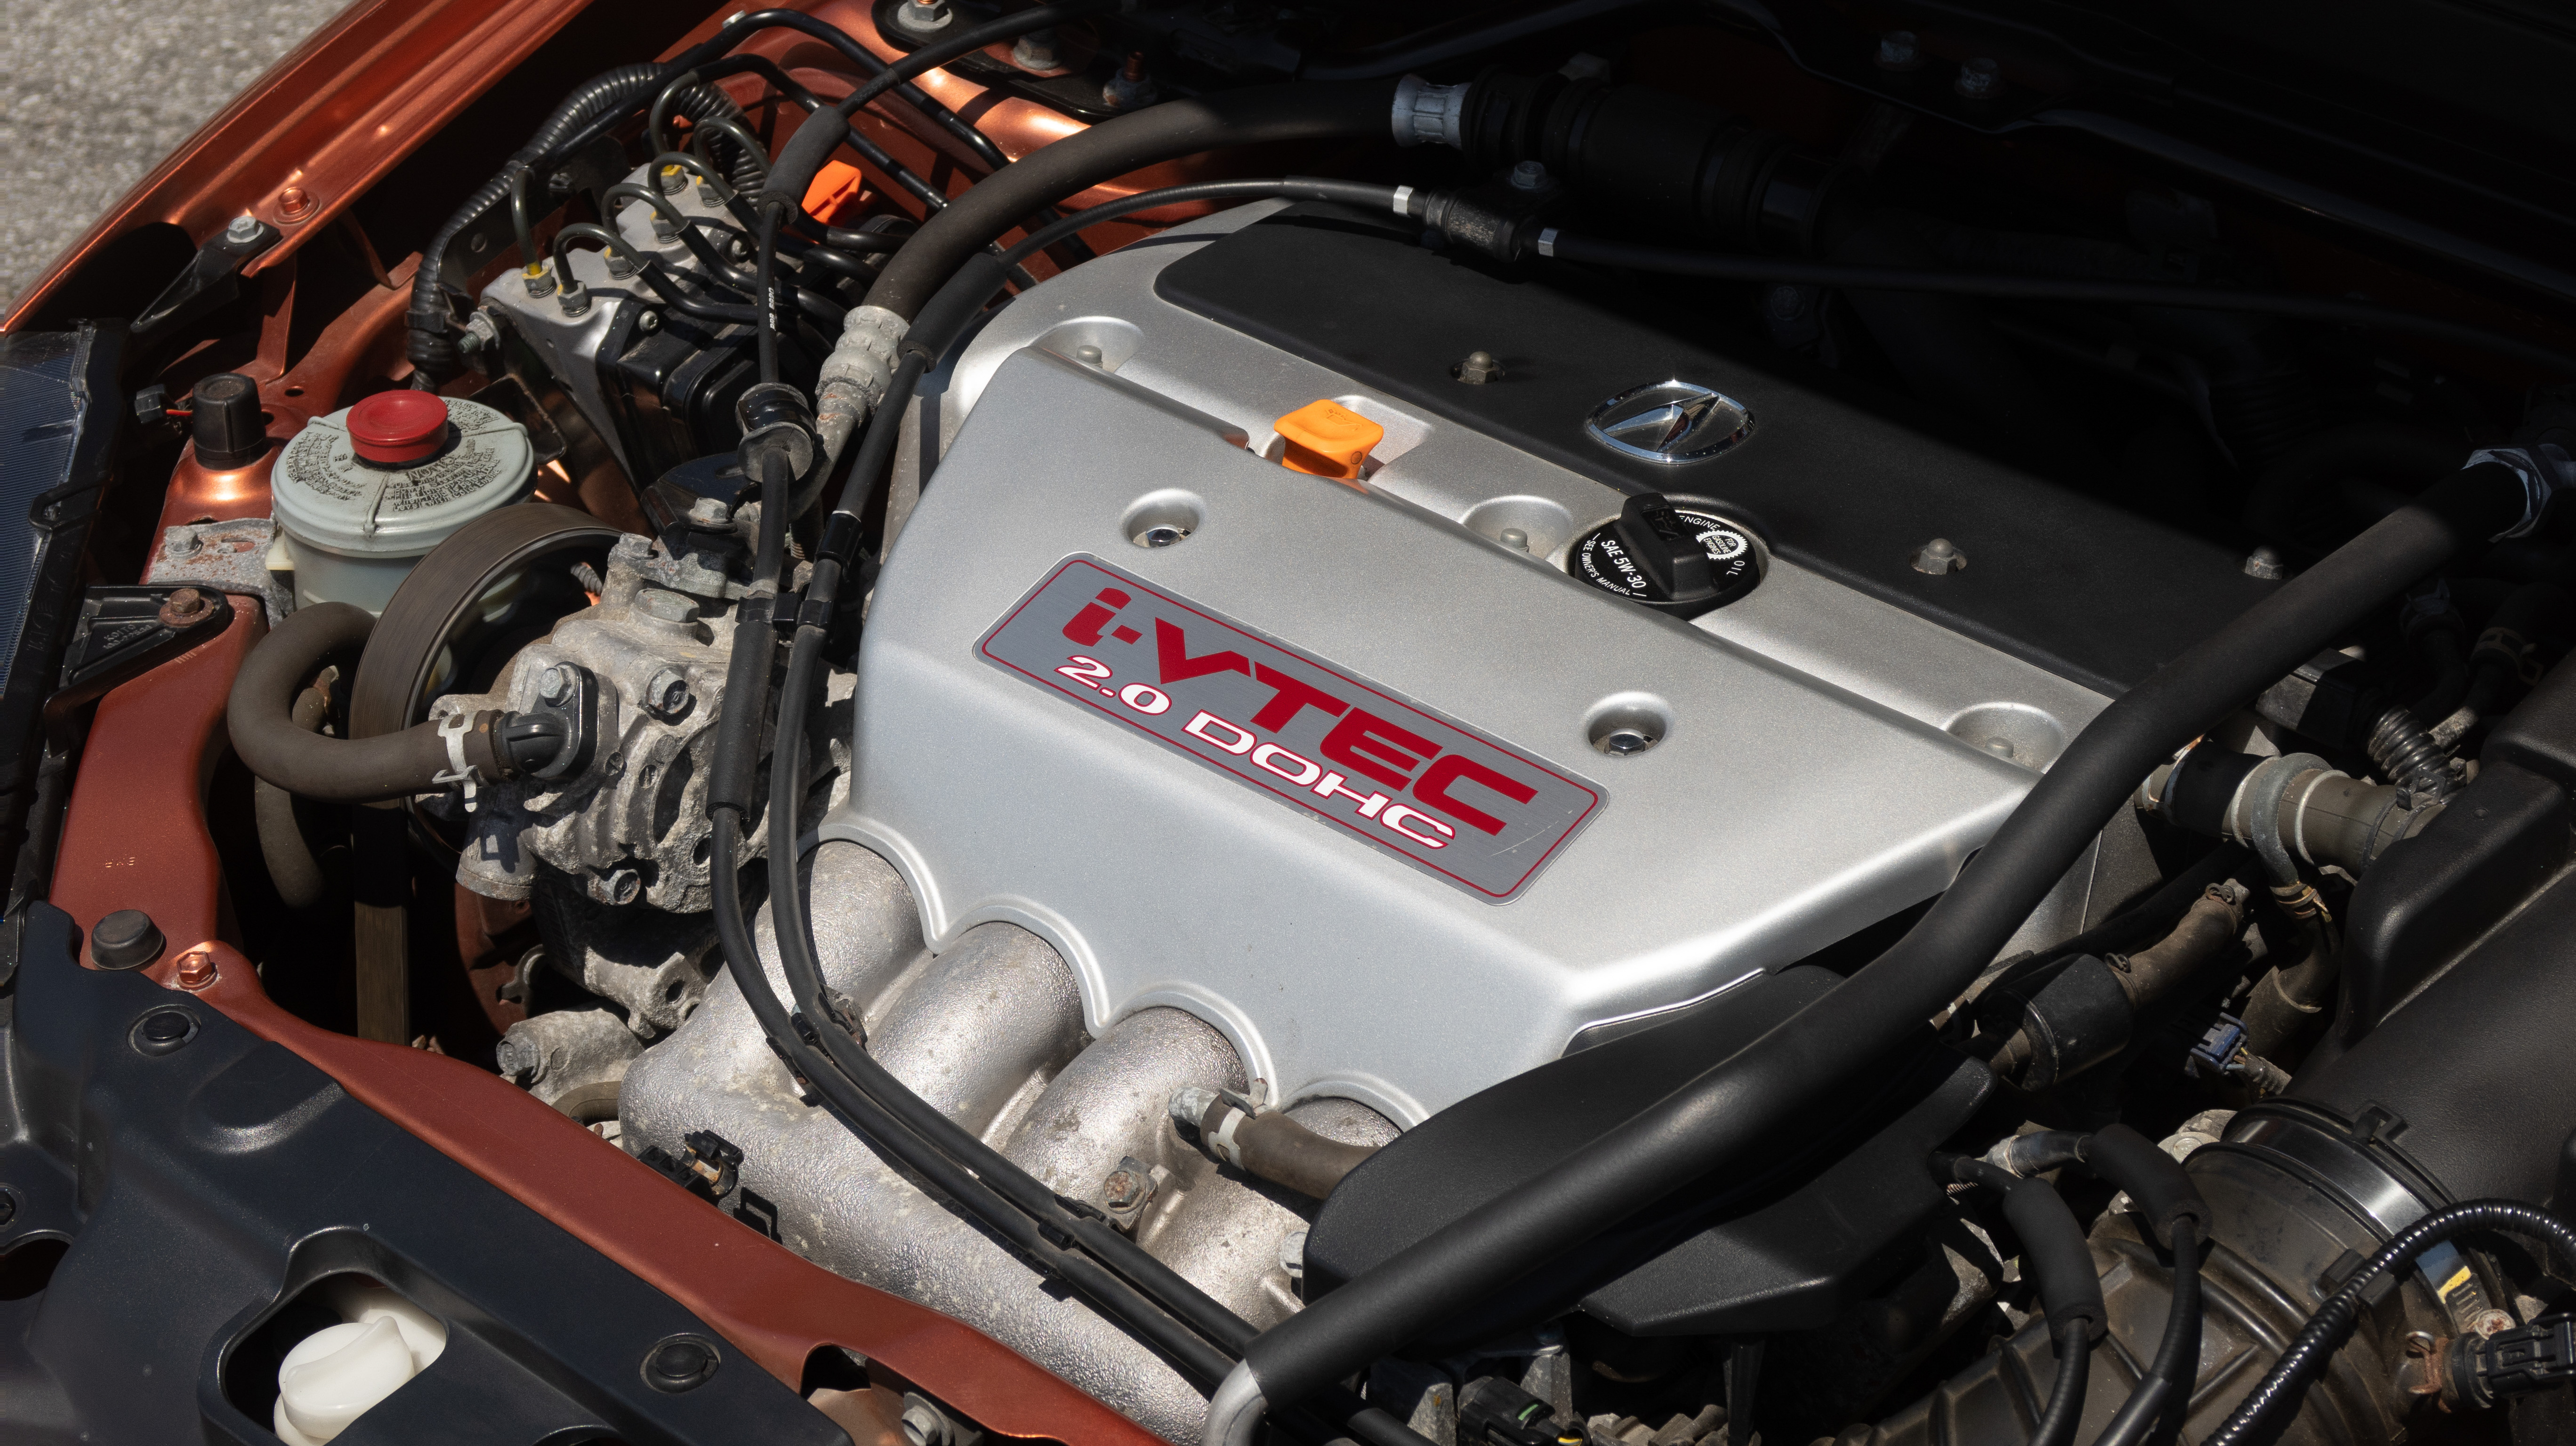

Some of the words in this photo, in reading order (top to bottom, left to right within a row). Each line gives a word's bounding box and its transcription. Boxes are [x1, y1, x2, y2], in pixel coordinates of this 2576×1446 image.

[1583, 540, 1596, 551] SEE
[1704, 538, 1721, 554] ENGINES
[1712, 535, 1731, 554] GASOLINE
[1725, 538, 1736, 547] FOR
[1582, 553, 1599, 578] OWNER'S
[1601, 540, 1624, 557] SAE
[1614, 557, 1646, 588] 5W-30
[1726, 561, 1745, 575] OIL
[1596, 577, 1630, 595] MANUAL
[104, 624, 136, 641] KOITO
[1063, 589, 1537, 835] i-VTEC
[1055, 655, 1171, 716] 2.0
[1182, 709, 1455, 849] DOHC
